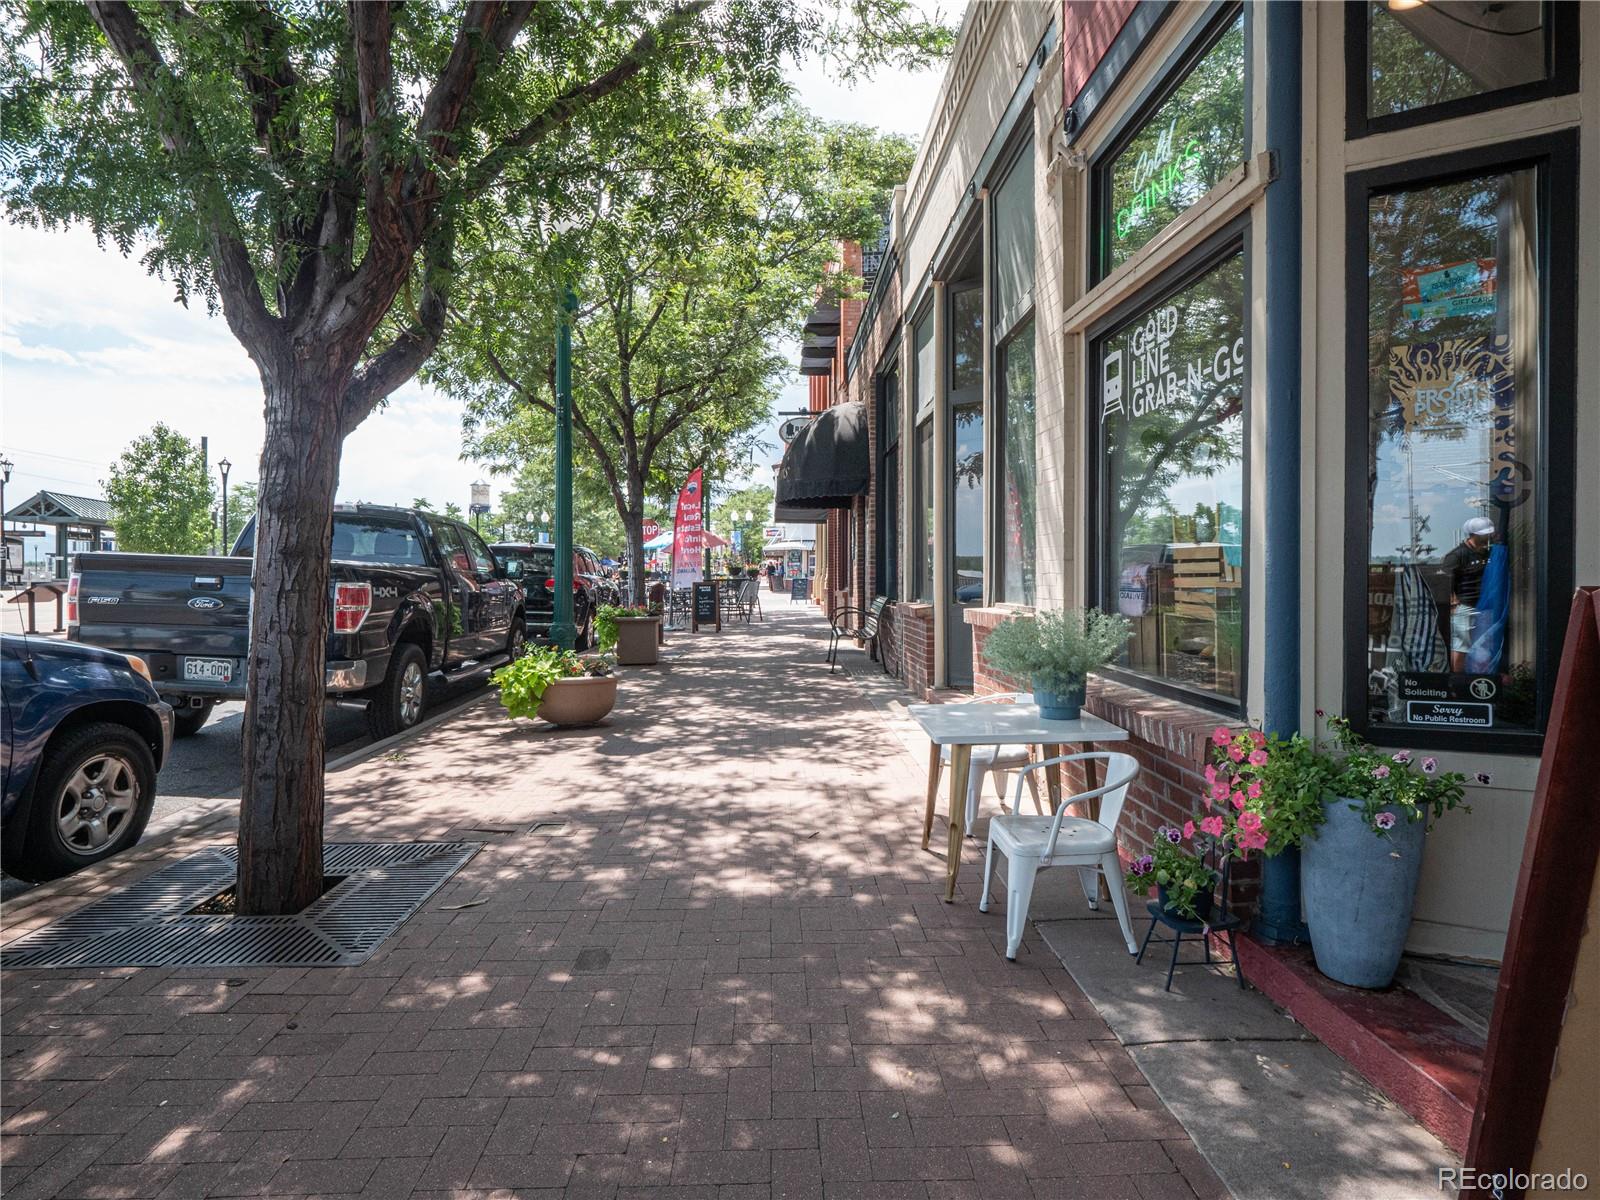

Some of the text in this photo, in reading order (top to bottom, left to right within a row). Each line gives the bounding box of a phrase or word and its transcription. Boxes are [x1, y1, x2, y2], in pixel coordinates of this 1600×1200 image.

[1134, 118, 1177, 193] Cold
[1116, 139, 1201, 240] DRINKS
[1132, 305, 1178, 356] GOLD
[1132, 341, 1170, 388] LINE
[642, 525, 658, 535] TOP
[194, 599, 214, 608] Ford
[1404, 688, 1447, 698] Soliciting
[1432, 704, 1463, 716] Sorry
[1424, 714, 1447, 722] Public
[1449, 715, 1486, 724] Restroom
